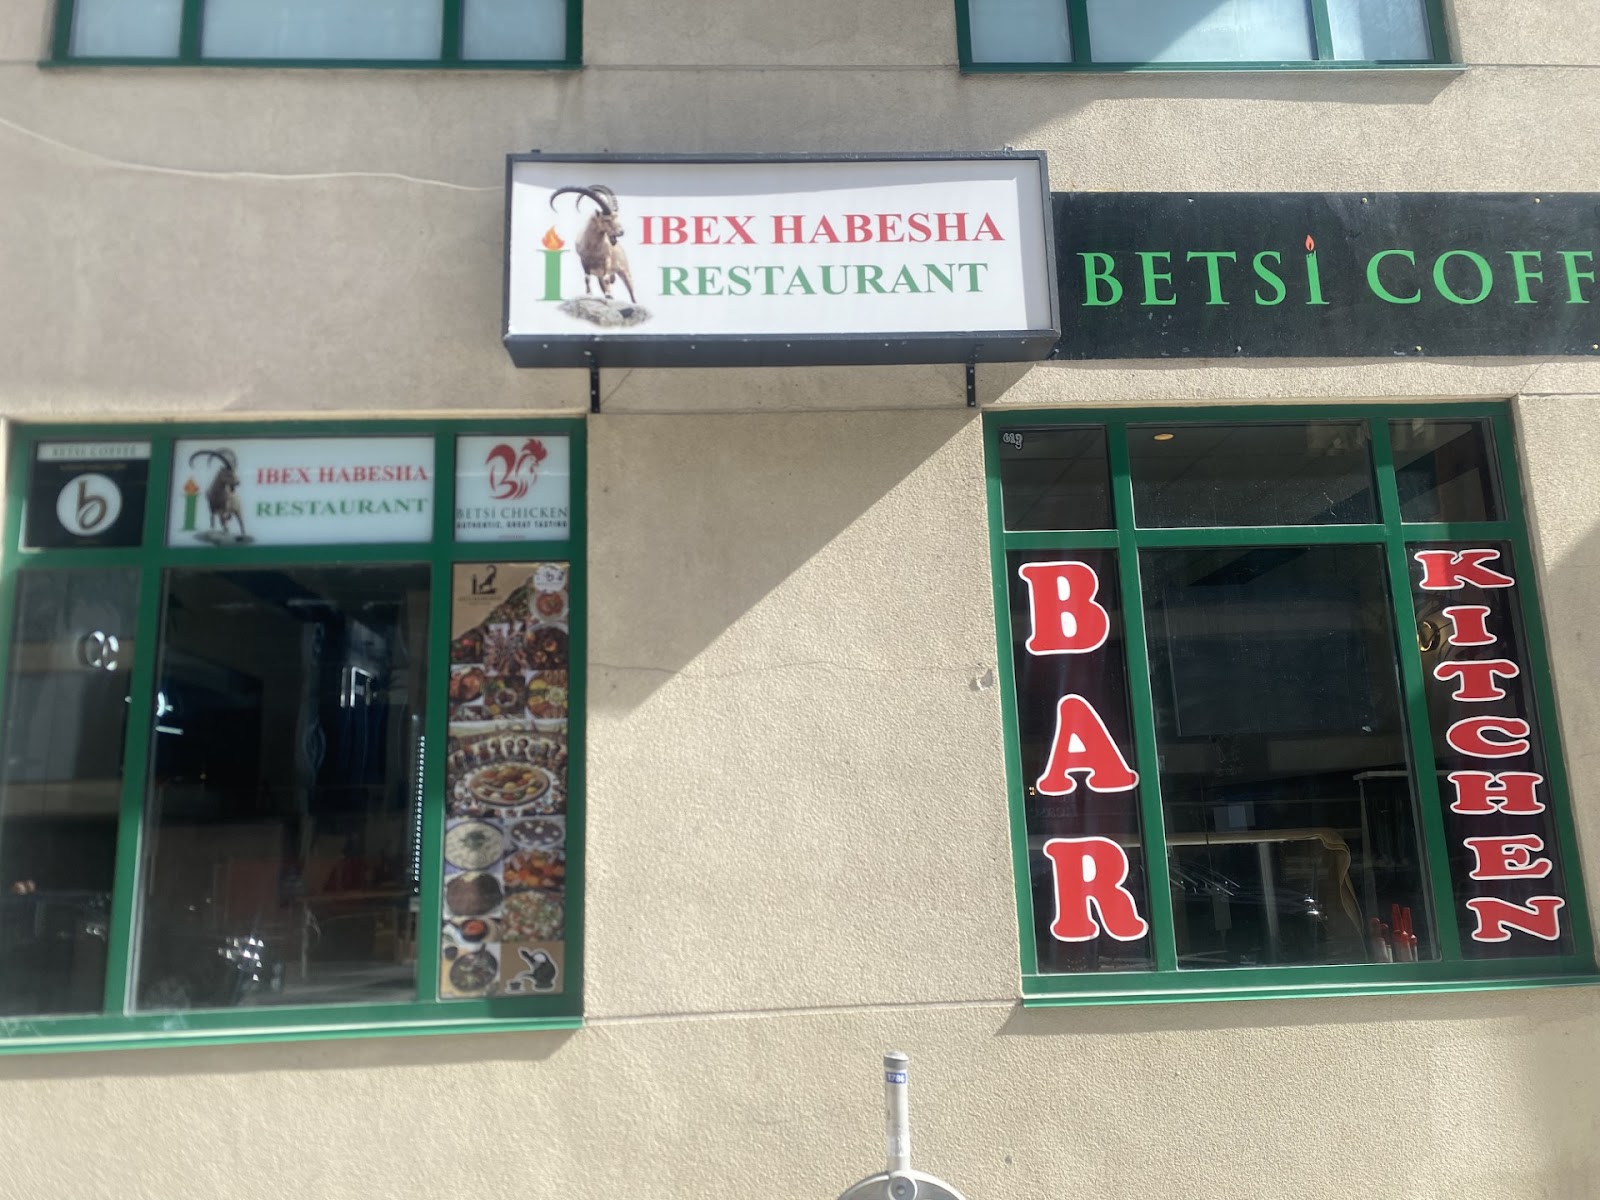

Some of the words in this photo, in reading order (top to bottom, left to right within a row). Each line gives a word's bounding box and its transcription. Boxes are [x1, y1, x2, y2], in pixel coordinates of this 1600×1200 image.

[638, 214, 758, 246] IBEX
[771, 211, 1006, 245] HABESHA
[657, 262, 989, 297] RESTAURANT
[1366, 249, 1597, 305] COFF
[256, 467, 311, 485] IBEX
[318, 464, 428, 483] HABESHA
[255, 498, 429, 518] RESTAURANT
[500, 505, 569, 519] CHICKEN
[1018, 560, 1149, 943] BAR
[1413, 548, 1566, 942] KITCHEN
